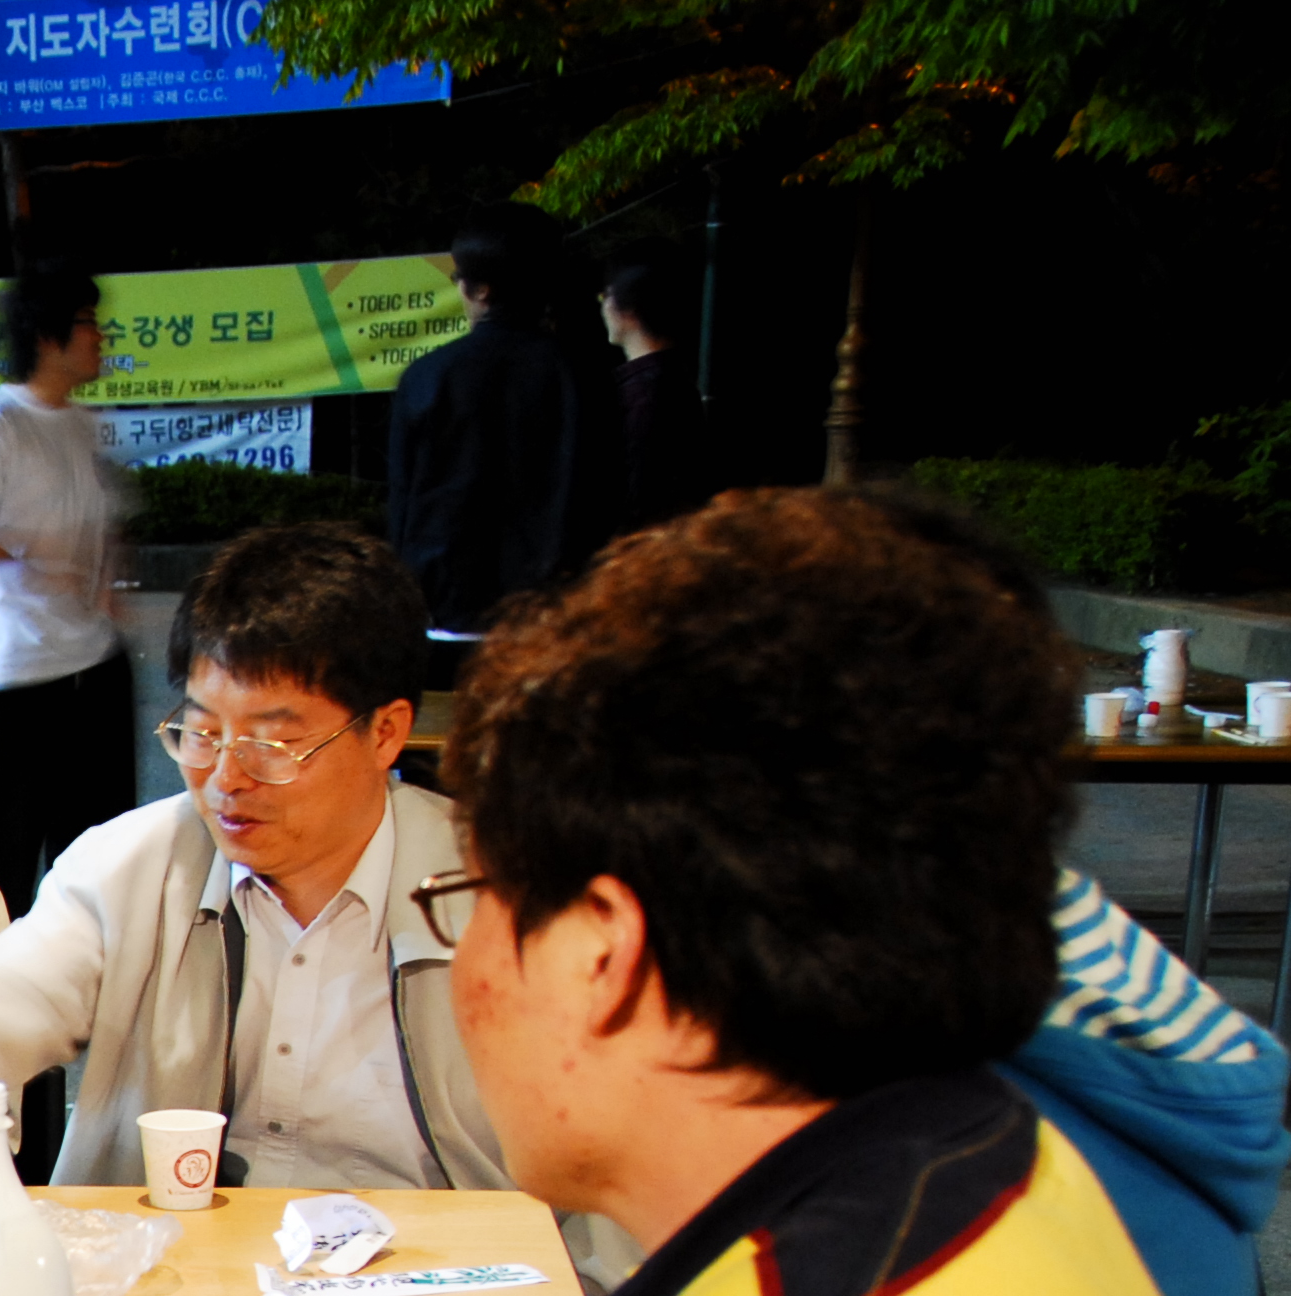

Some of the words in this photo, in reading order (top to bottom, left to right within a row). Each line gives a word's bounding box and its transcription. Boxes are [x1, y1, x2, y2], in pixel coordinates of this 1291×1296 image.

[20, 98, 44, 114] 부산
[152, 89, 179, 105] 국제
[359, 293, 402, 313] TOEIC
[407, 290, 435, 310] ELS
[99, 313, 195, 349] 수강생
[209, 310, 276, 343] 모집
[368, 319, 417, 340] SPEED
[424, 315, 468, 336] TOEIC
[105, 379, 173, 398] 평생교육원
